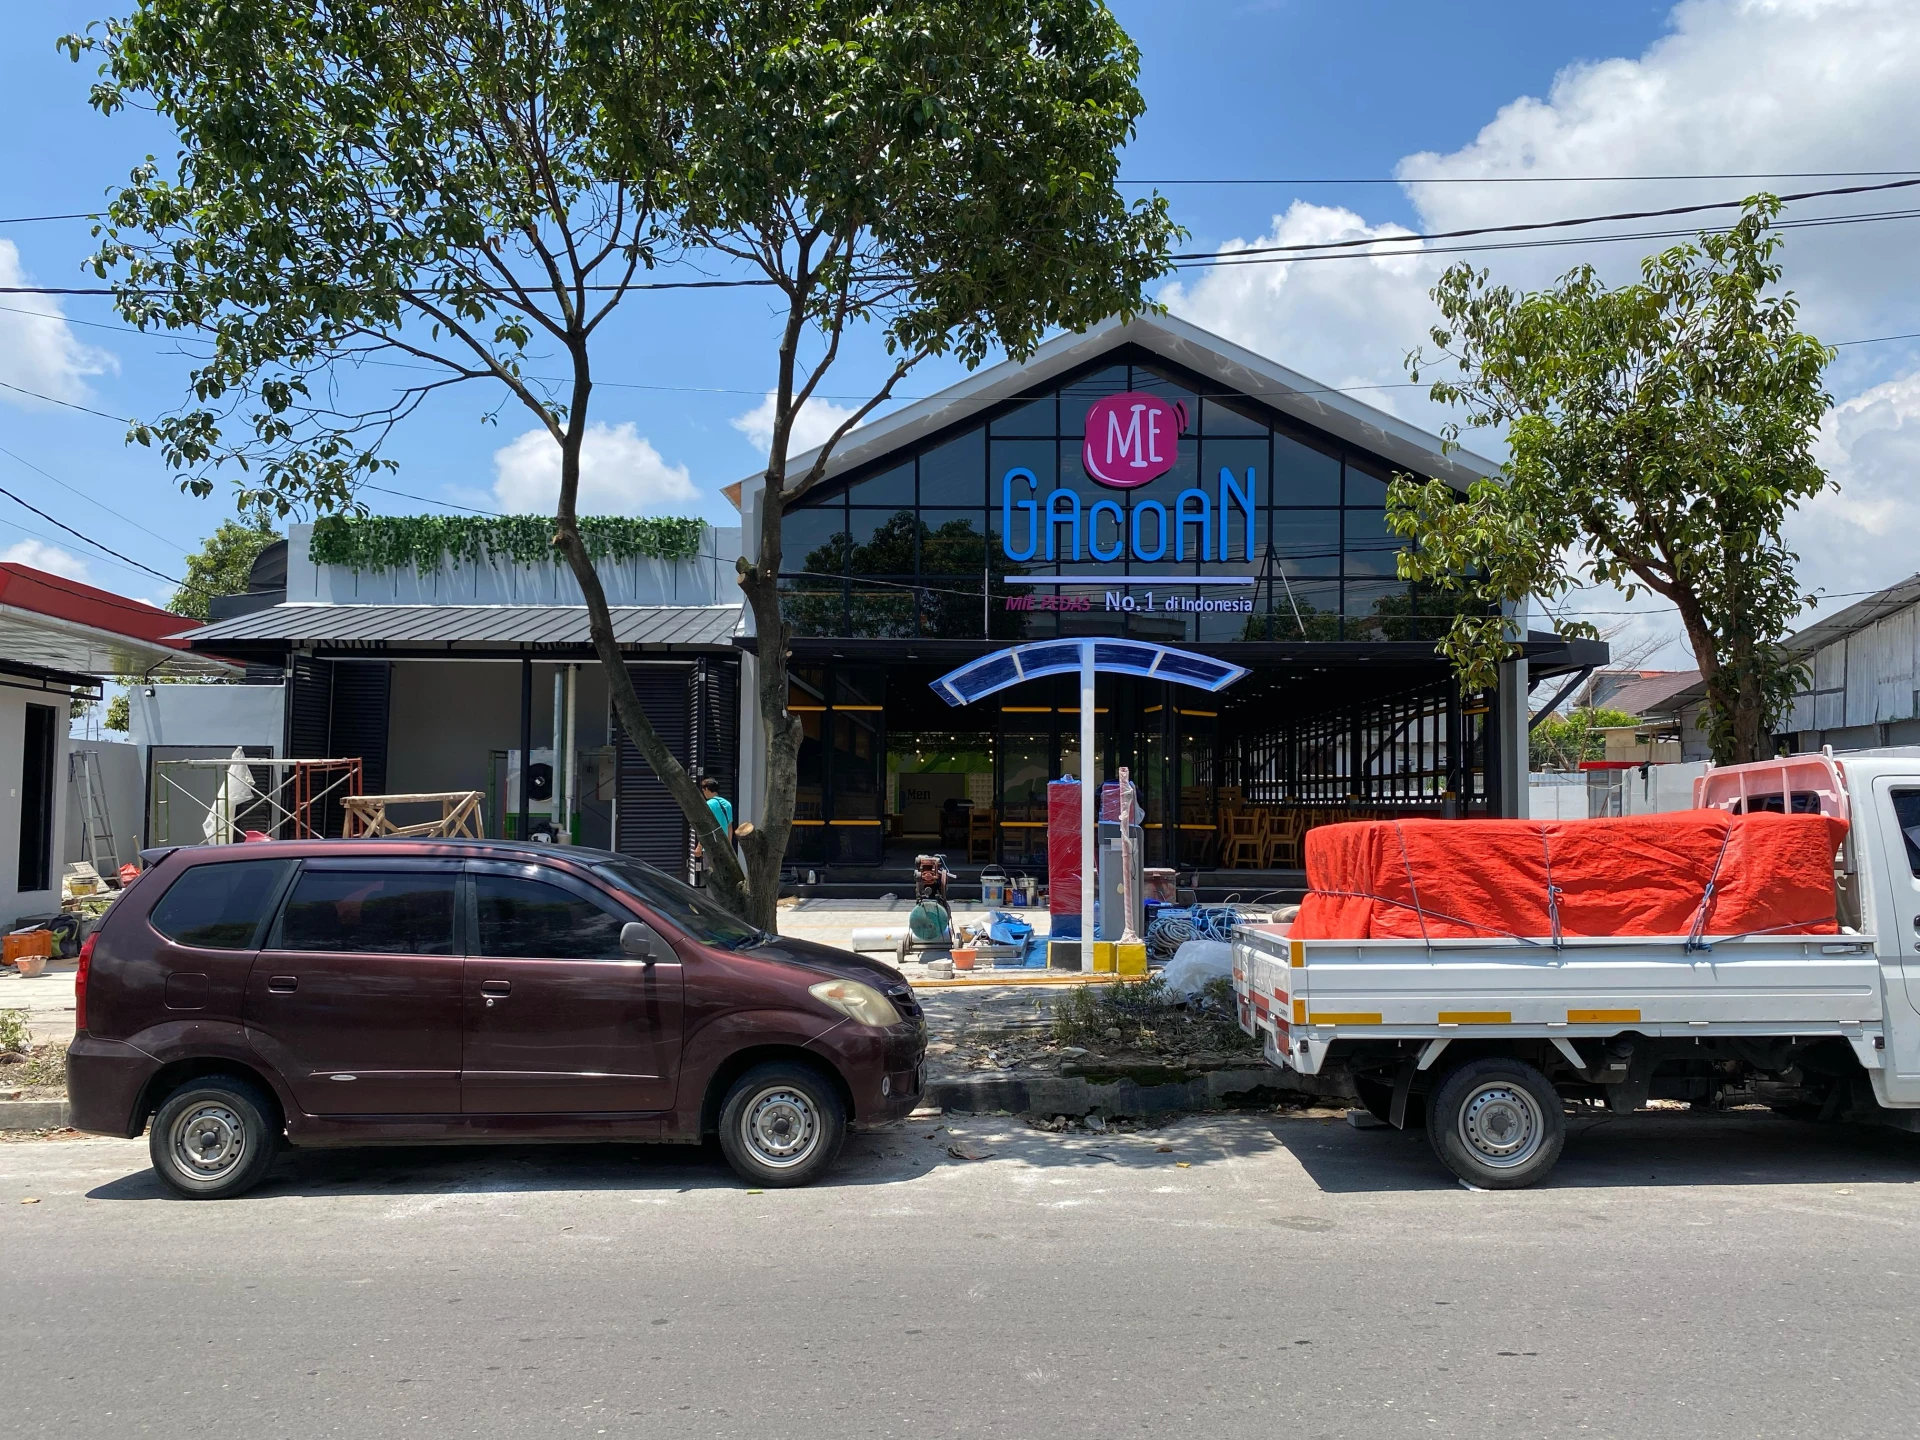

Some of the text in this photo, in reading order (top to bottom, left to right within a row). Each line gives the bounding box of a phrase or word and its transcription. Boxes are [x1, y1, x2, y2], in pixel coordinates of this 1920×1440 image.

[1005, 595, 1035, 611] MIE
[1041, 595, 1091, 611] PEDAS
[1165, 596, 1178, 611] di
[1181, 596, 1253, 612] Indonesia
[907, 788, 931, 800] Men
